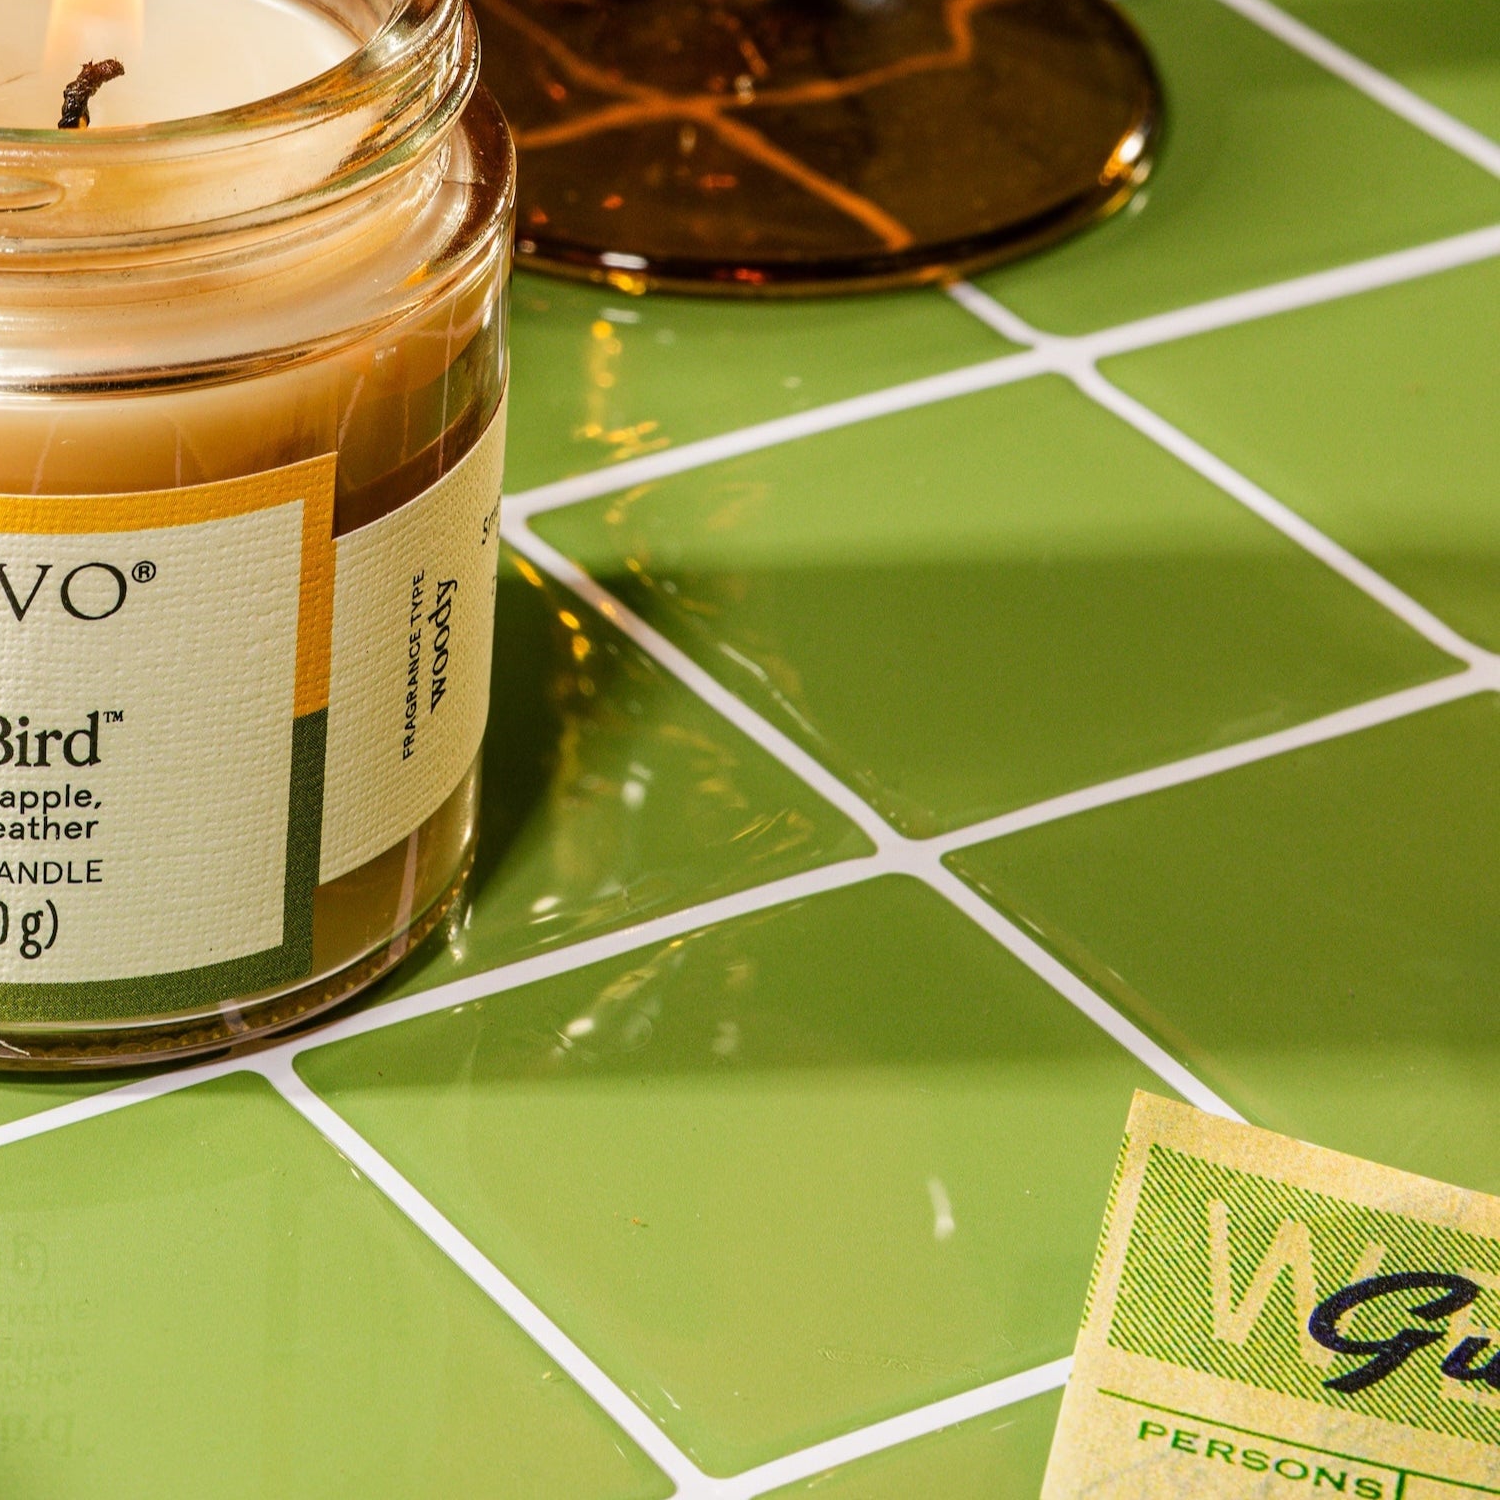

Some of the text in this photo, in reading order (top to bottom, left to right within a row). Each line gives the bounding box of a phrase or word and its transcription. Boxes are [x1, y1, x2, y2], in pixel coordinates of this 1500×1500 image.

[402, 569, 425, 762] FRAGRANCE TYPE
[427, 578, 458, 716] woody
[19, 899, 59, 960] g)
[1136, 1419, 1384, 1500] PERSONS
